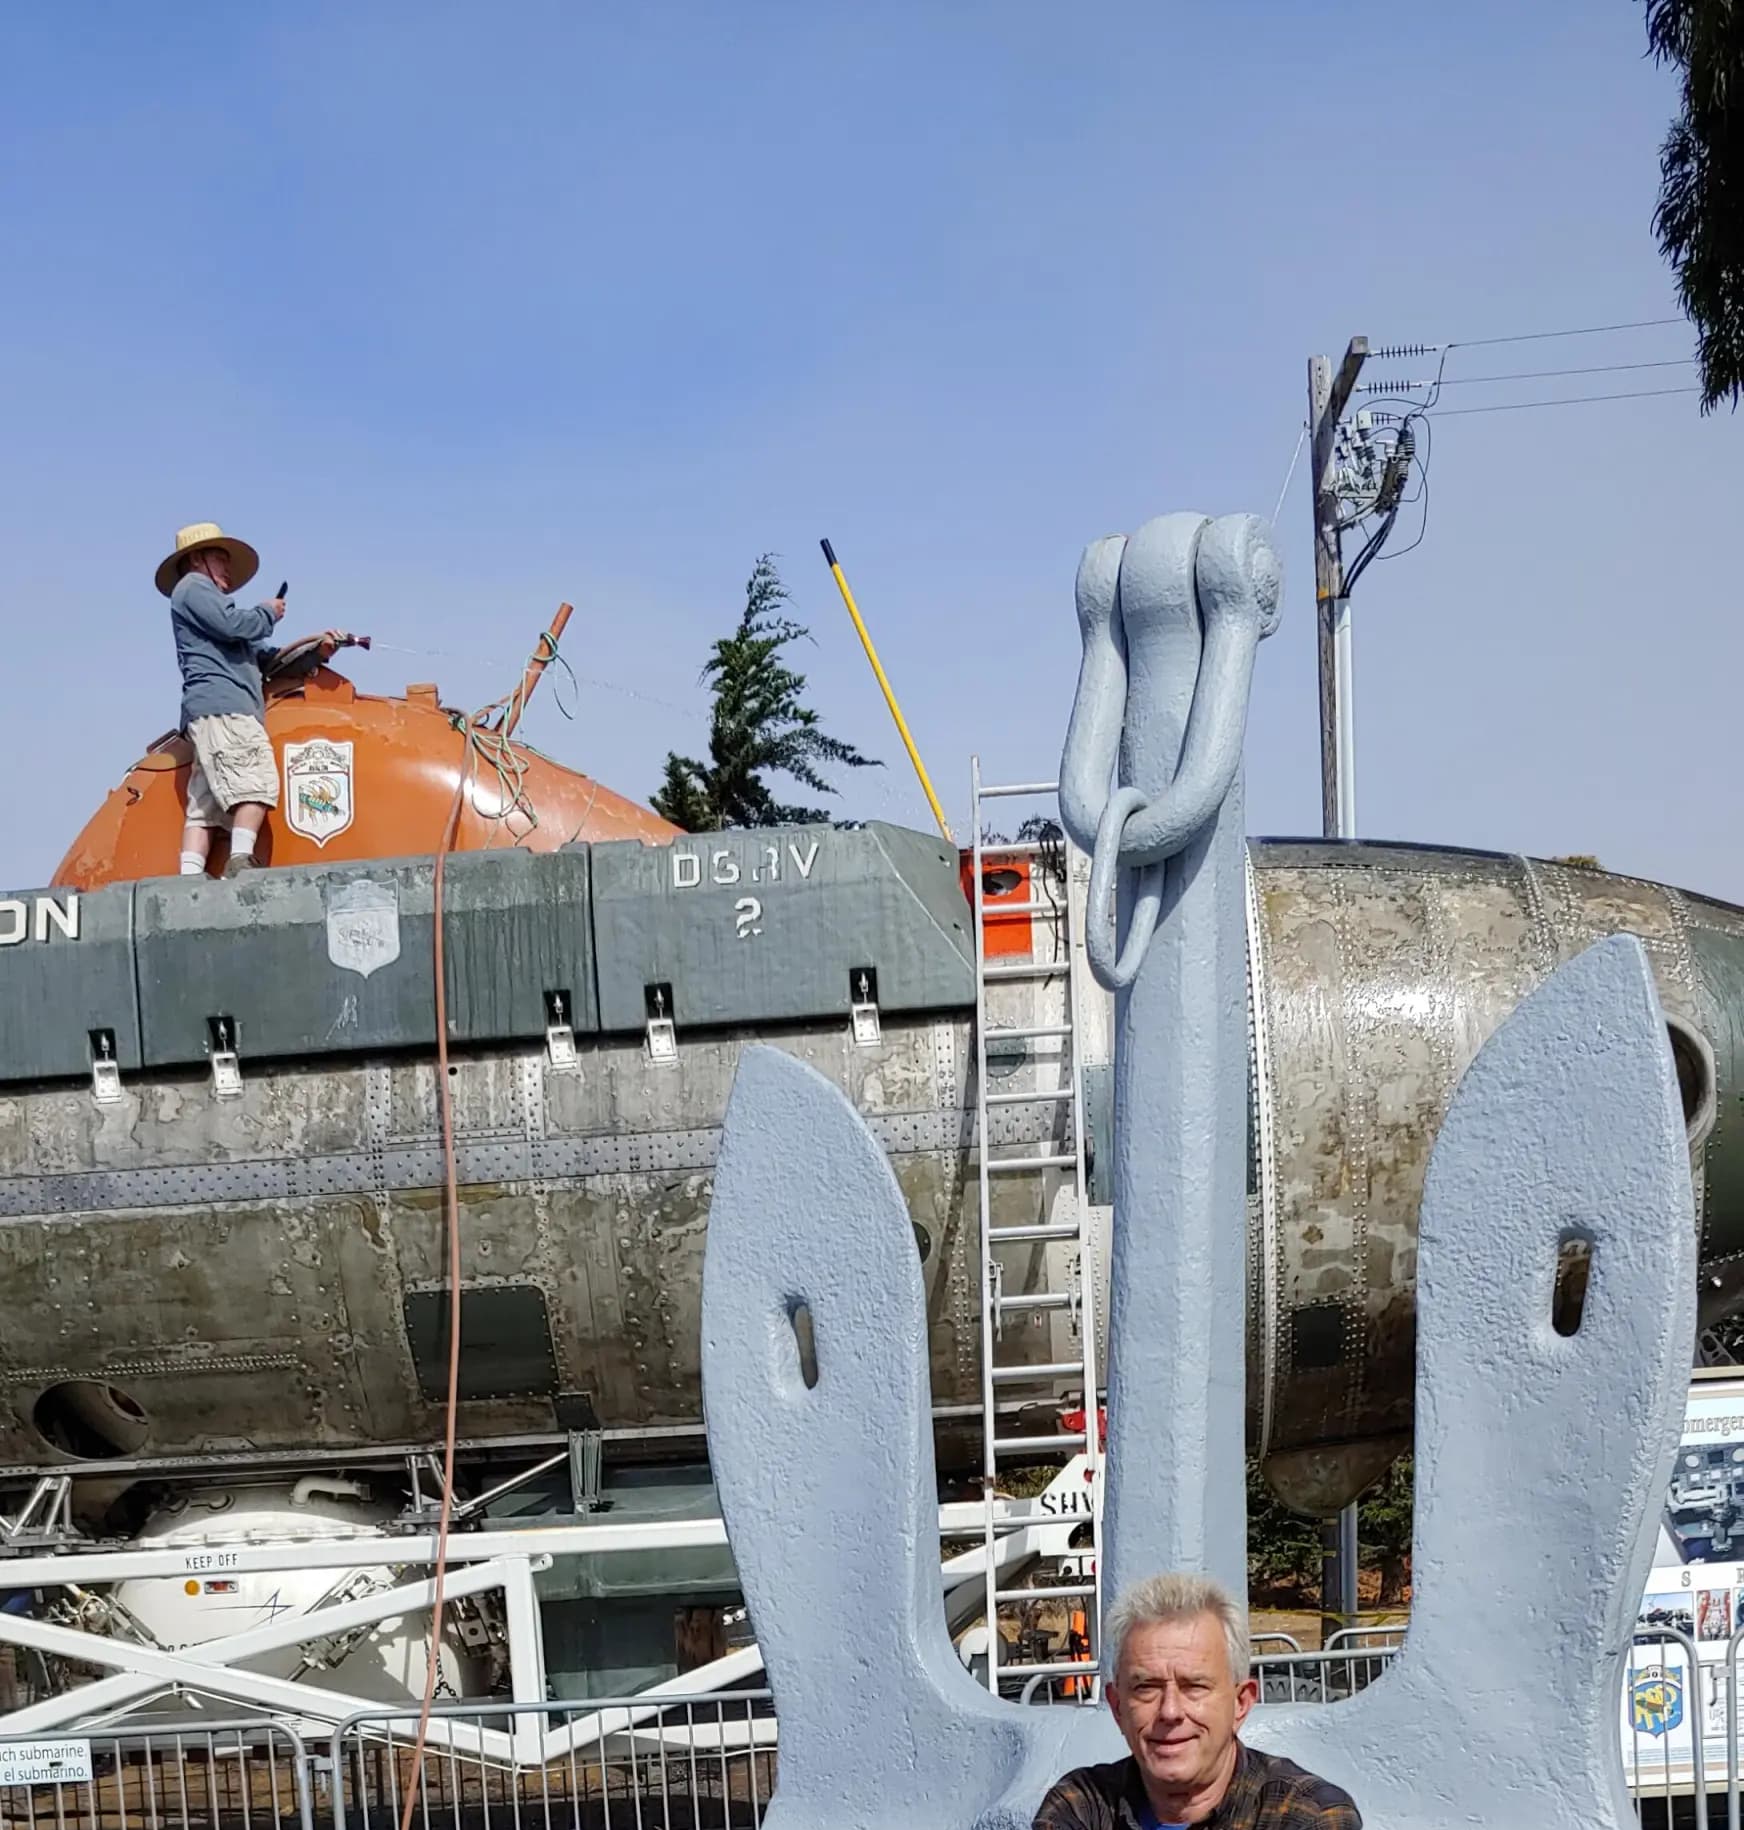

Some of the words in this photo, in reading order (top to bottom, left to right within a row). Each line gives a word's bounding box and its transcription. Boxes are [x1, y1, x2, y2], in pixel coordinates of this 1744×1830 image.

[734, 897, 764, 938] 2
[185, 1555, 213, 1569] KEEP
[218, 1553, 238, 1567] OFF
[4, 1769, 15, 1782] el
